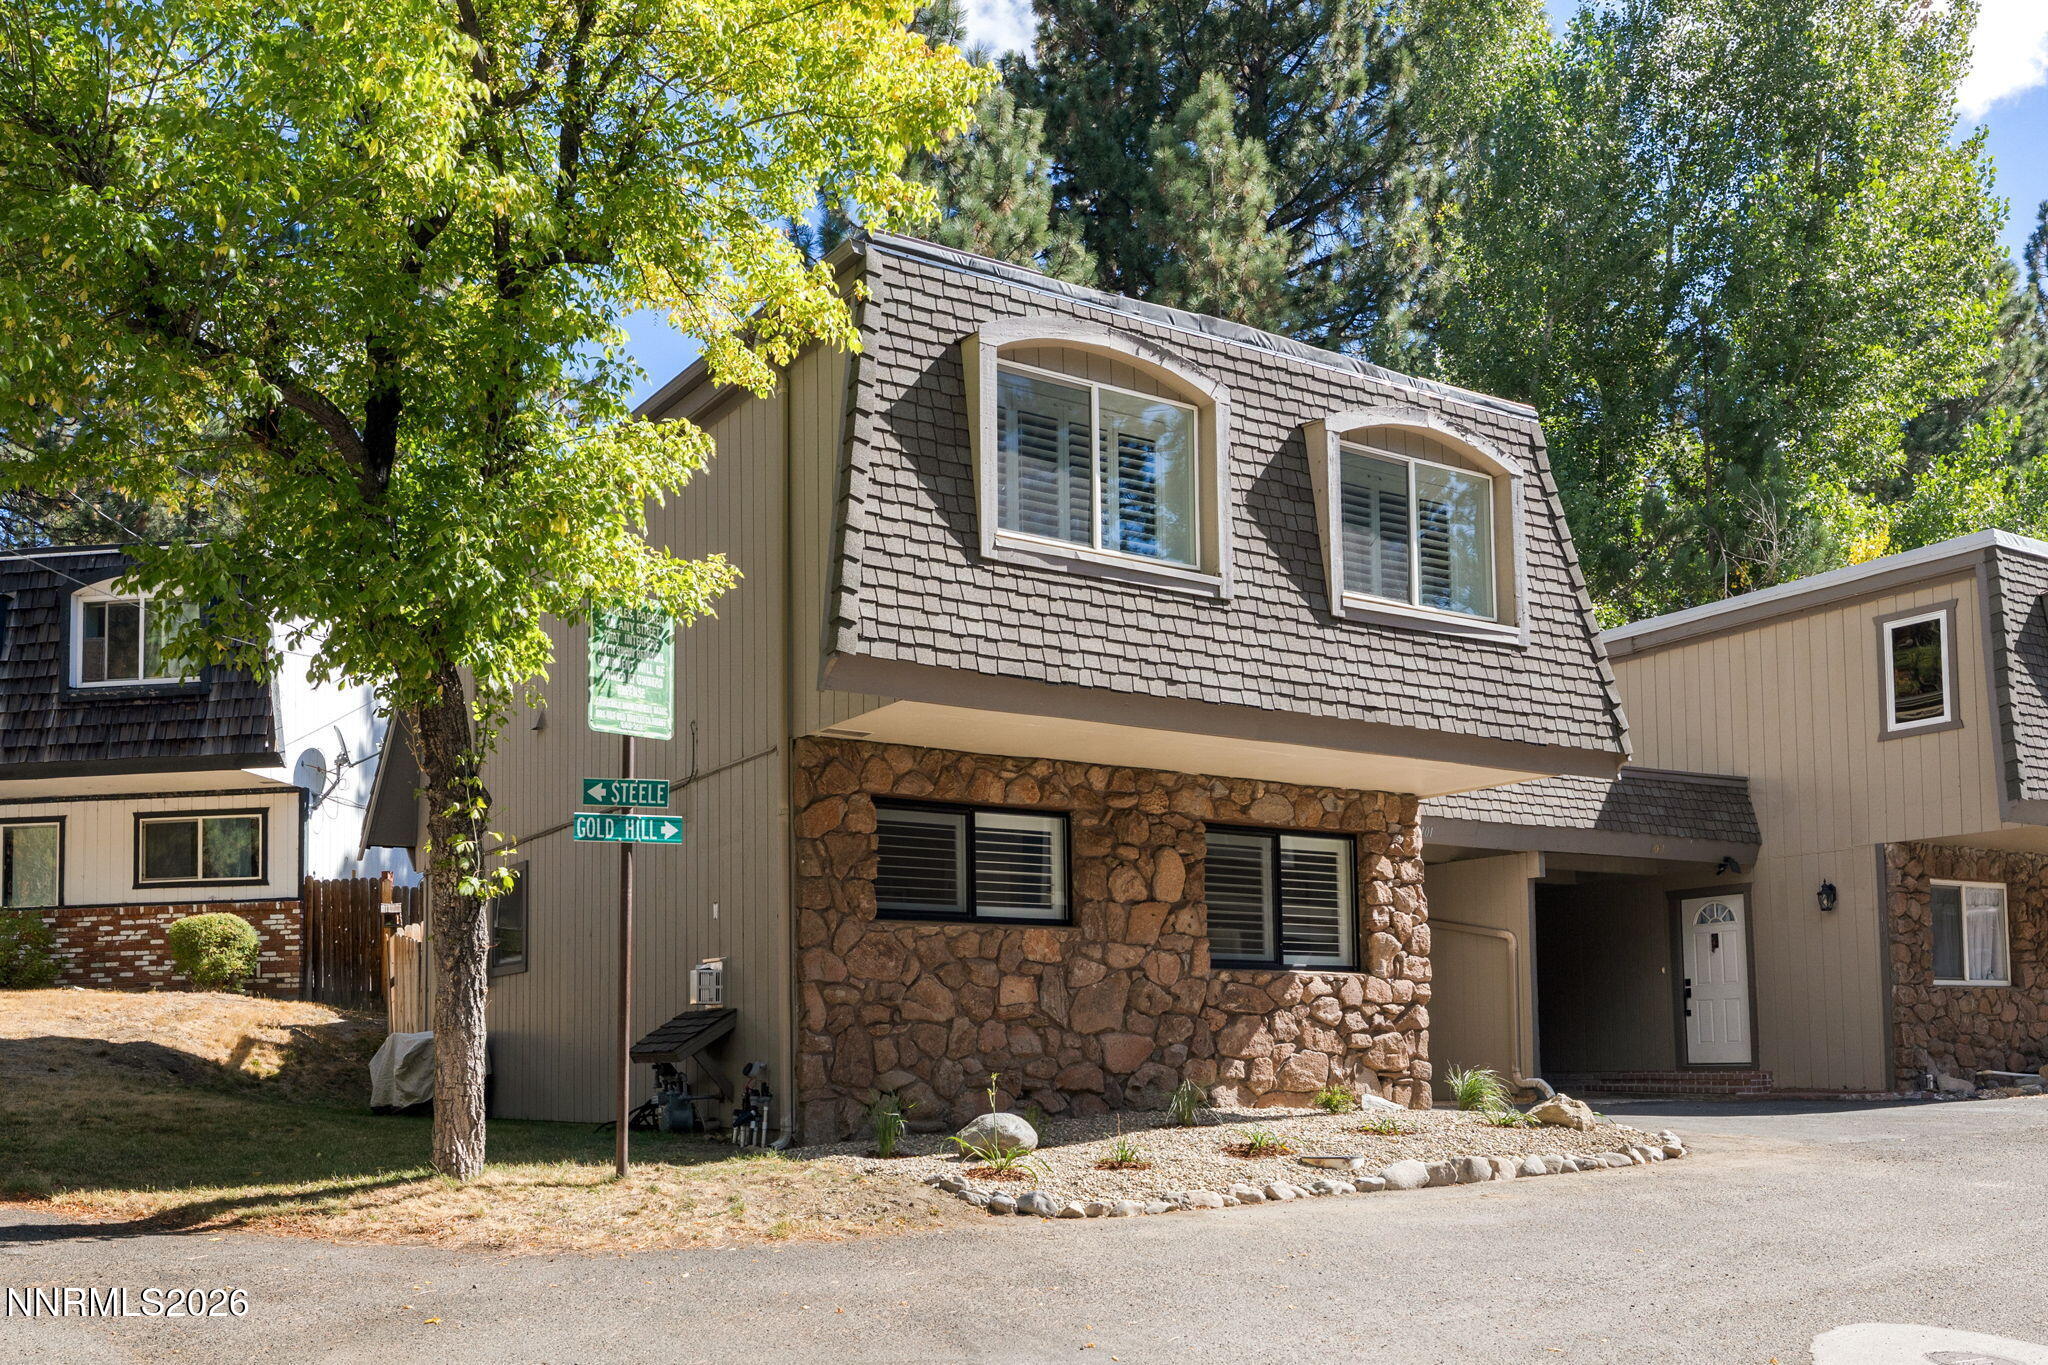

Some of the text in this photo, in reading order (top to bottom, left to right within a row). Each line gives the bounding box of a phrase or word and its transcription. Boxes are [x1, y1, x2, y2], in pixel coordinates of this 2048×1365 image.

[619, 620, 633, 632] ANY
[636, 622, 659, 636] STREET
[611, 782, 666, 804] STEELE
[577, 817, 658, 840] GOLD HILL
